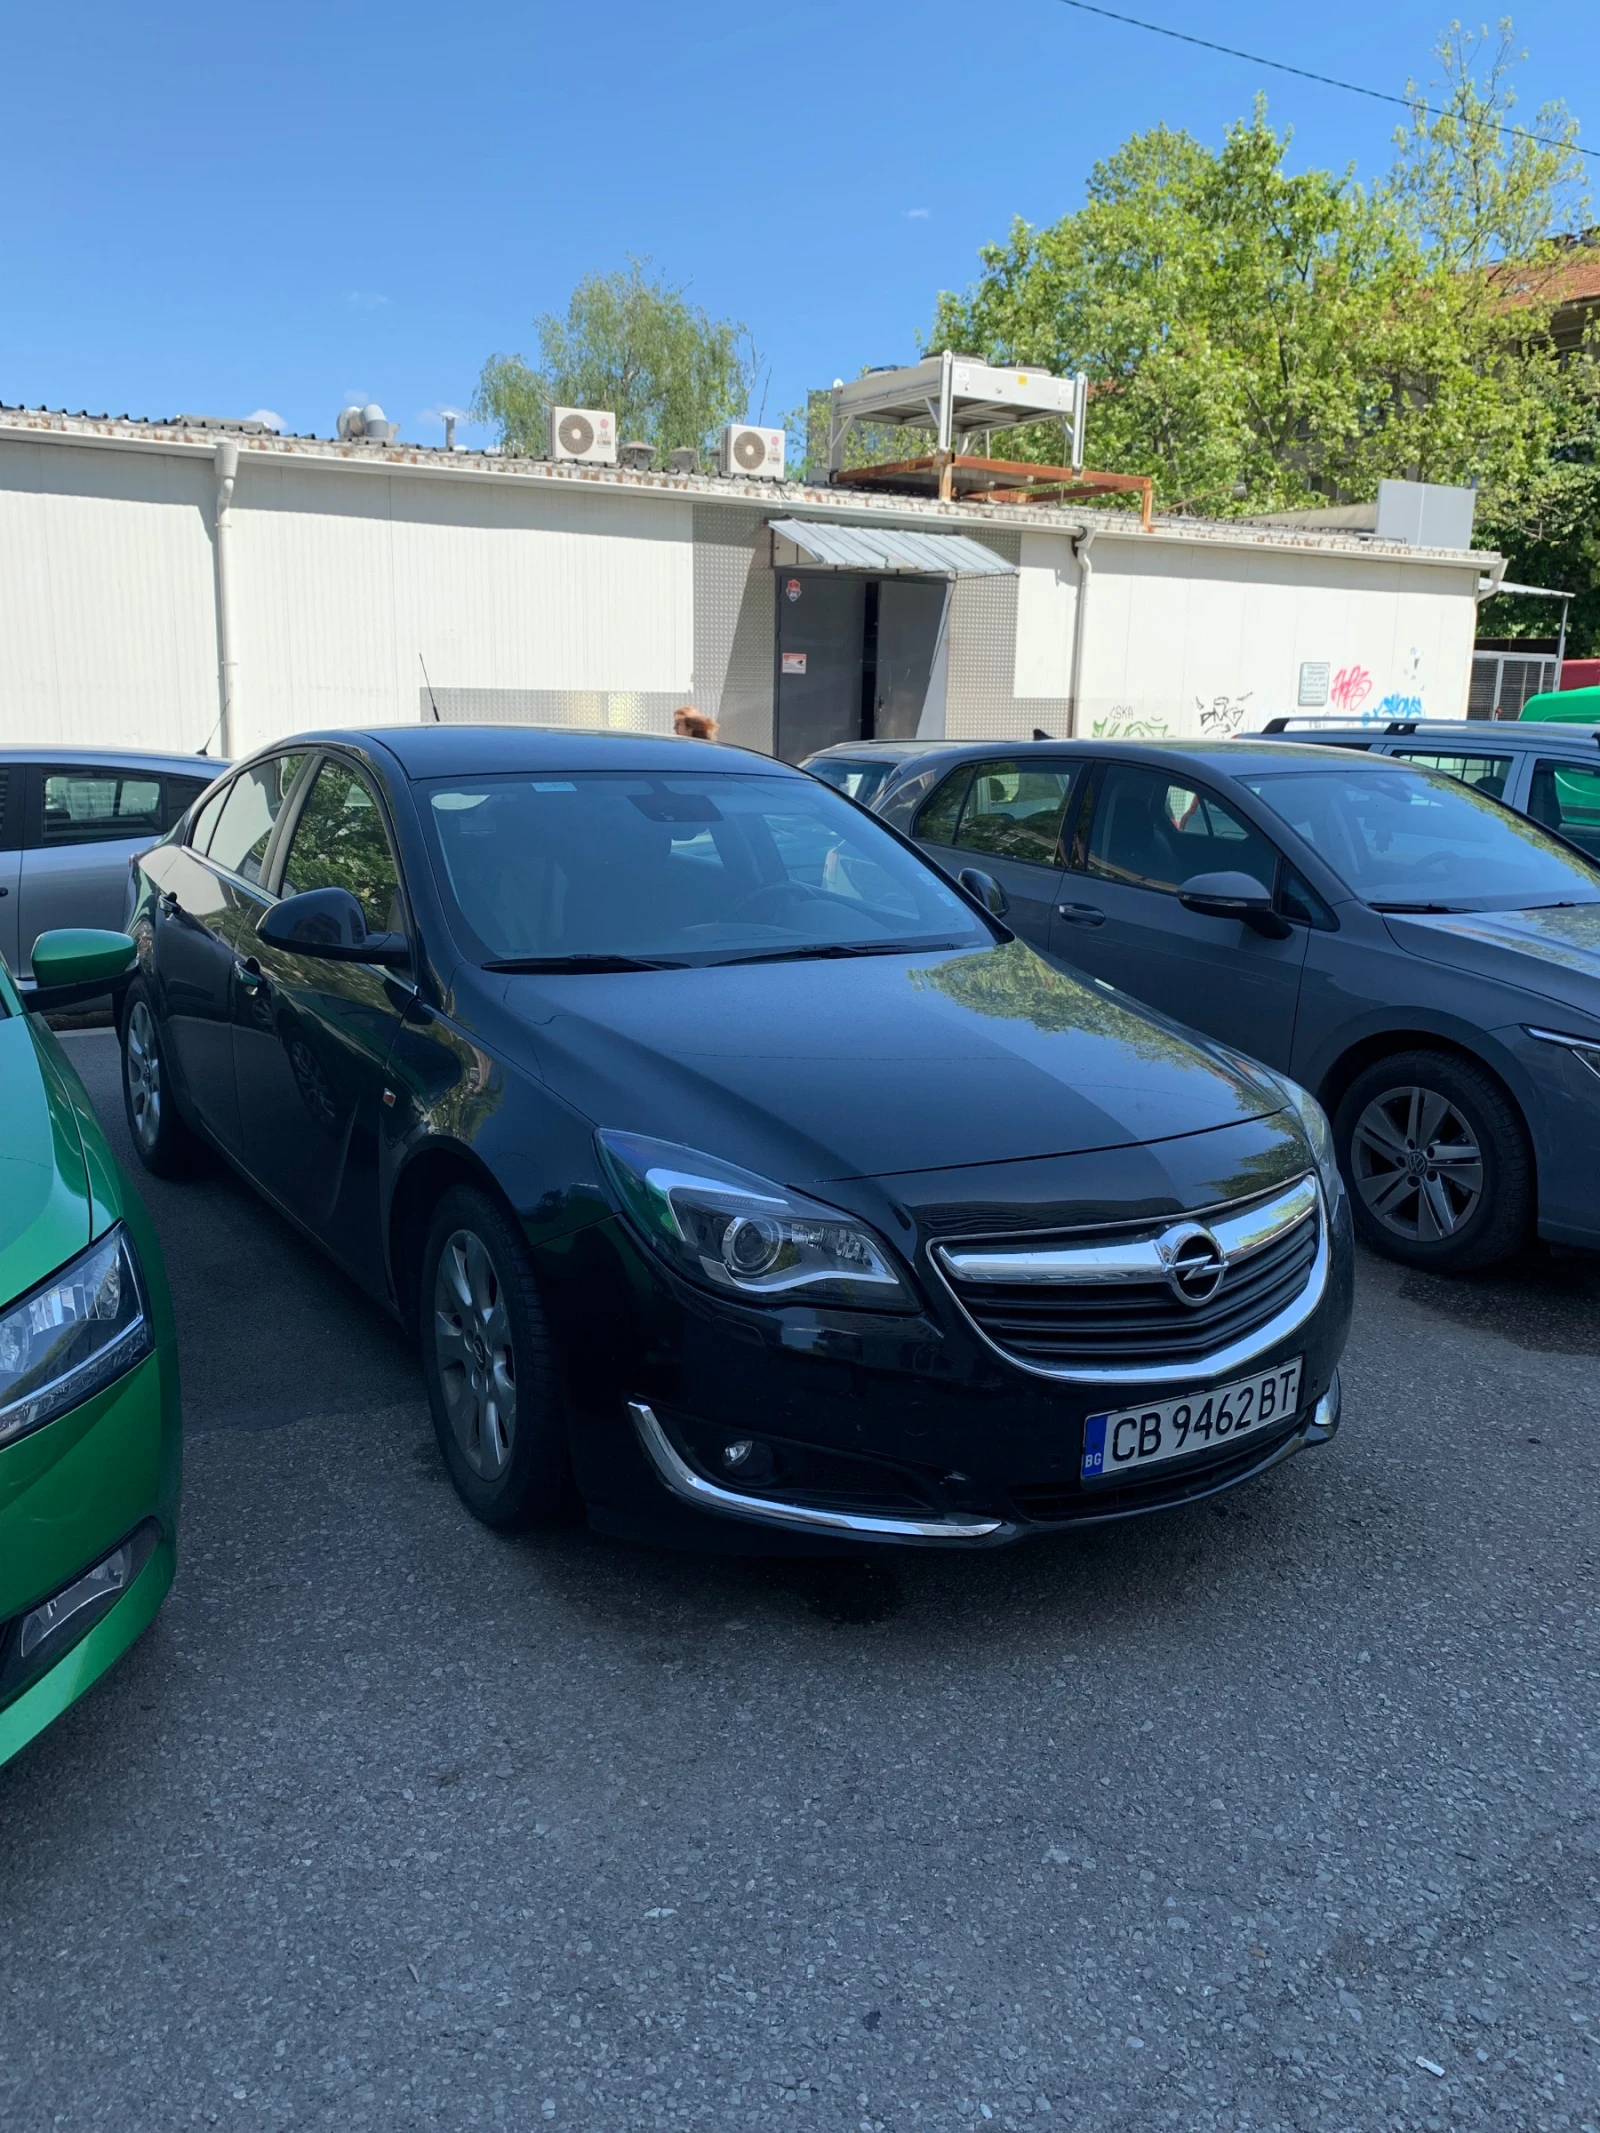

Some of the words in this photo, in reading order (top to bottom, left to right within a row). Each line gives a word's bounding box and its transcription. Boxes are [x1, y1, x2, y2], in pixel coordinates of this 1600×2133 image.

[1109, 705, 1133, 720] CSKA
[1172, 1387, 1254, 1449] 9462
[1084, 1452, 1102, 1468] BG
